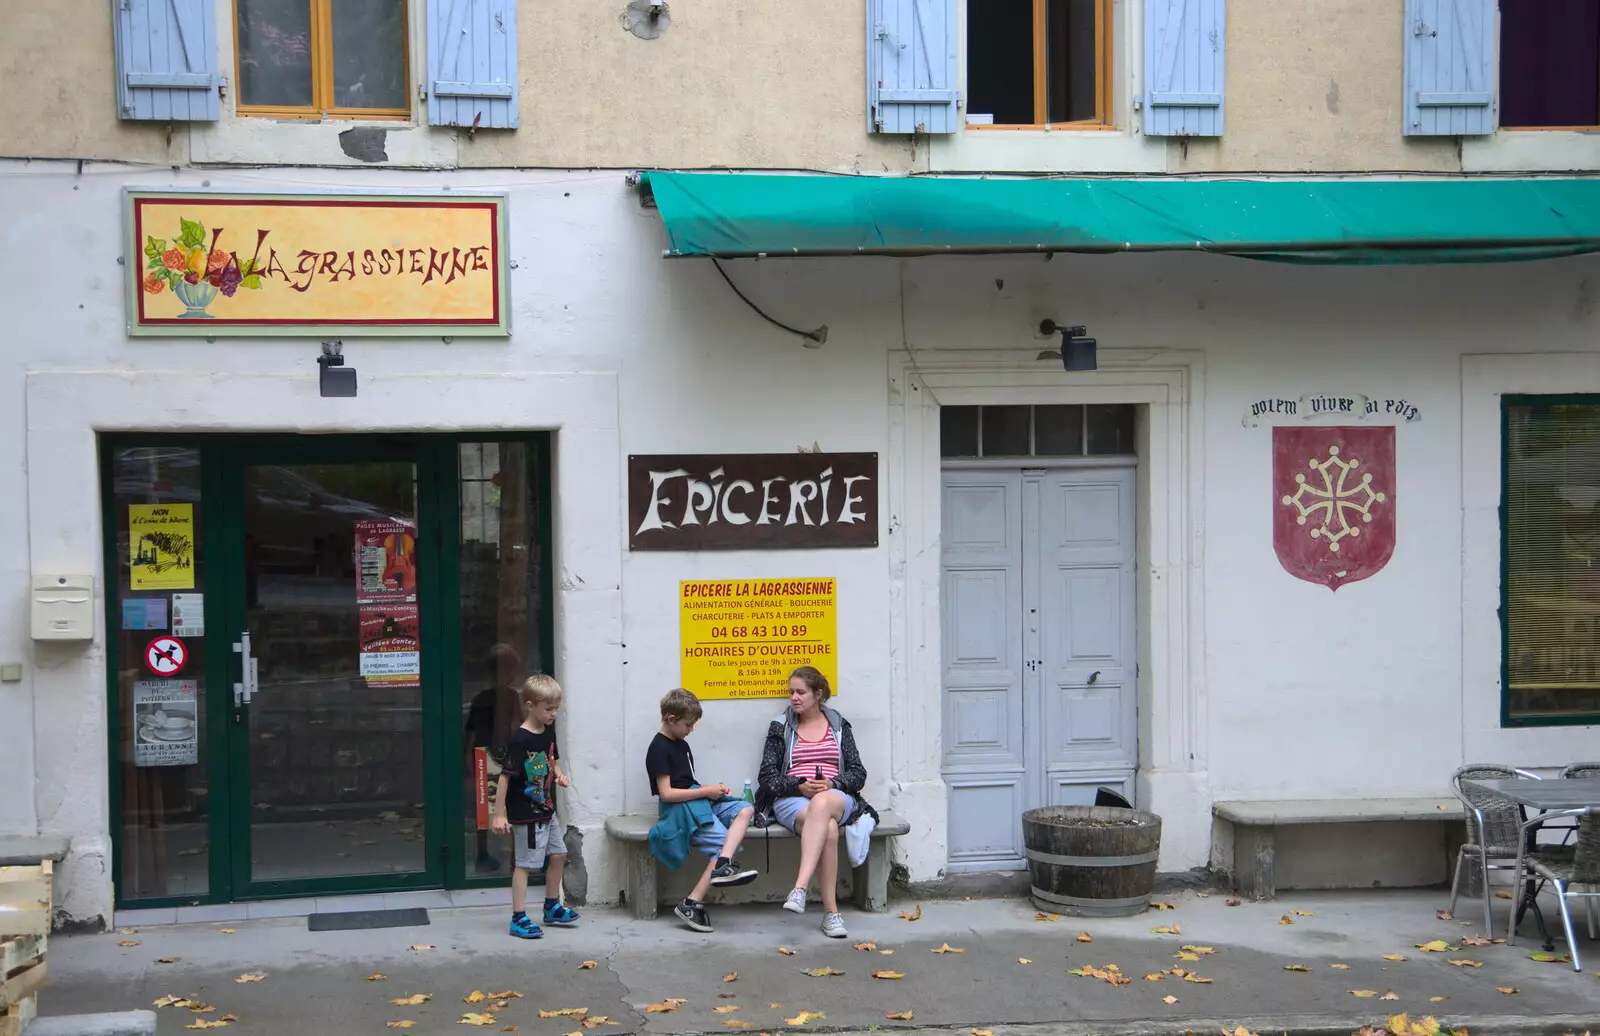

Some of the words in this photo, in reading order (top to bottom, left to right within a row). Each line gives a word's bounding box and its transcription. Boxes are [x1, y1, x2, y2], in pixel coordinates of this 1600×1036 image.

[635, 466, 872, 536] EPICERIE
[683, 583, 732, 597] EPICERIE
[736, 583, 749, 596] LA
[753, 581, 833, 596] LAGRASSIENNE
[684, 600, 742, 609] ALIMENTATION
[744, 599, 783, 608] GÉNÉRALE
[790, 599, 833, 607] BOUCHERIE
[692, 612, 745, 621] CHARCUTERIE
[751, 612, 774, 620] PLATS
[783, 611, 825, 619] EMPORTER
[711, 626, 727, 638] 04
[731, 626, 748, 638] 68
[752, 625, 767, 637] 43
[772, 625, 788, 637] 10
[791, 624, 807, 636] 89
[685, 646, 745, 658] HORAIRES
[748, 644, 831, 656] D'OUVERTURE
[708, 660, 726, 668] Tous
[727, 659, 738, 667] les
[739, 659, 758, 668] jours
[760, 658, 769, 666] de
[782, 657, 786, 665] à
[789, 657, 811, 665] 12h30
[762, 668, 766, 676] à
[768, 668, 782, 676] 19h
[704, 679, 727, 687] Fermé
[729, 679, 736, 687] le
[738, 678, 774, 687] Dimanche
[729, 689, 738, 697] et
[747, 687, 768, 696] Lundi
